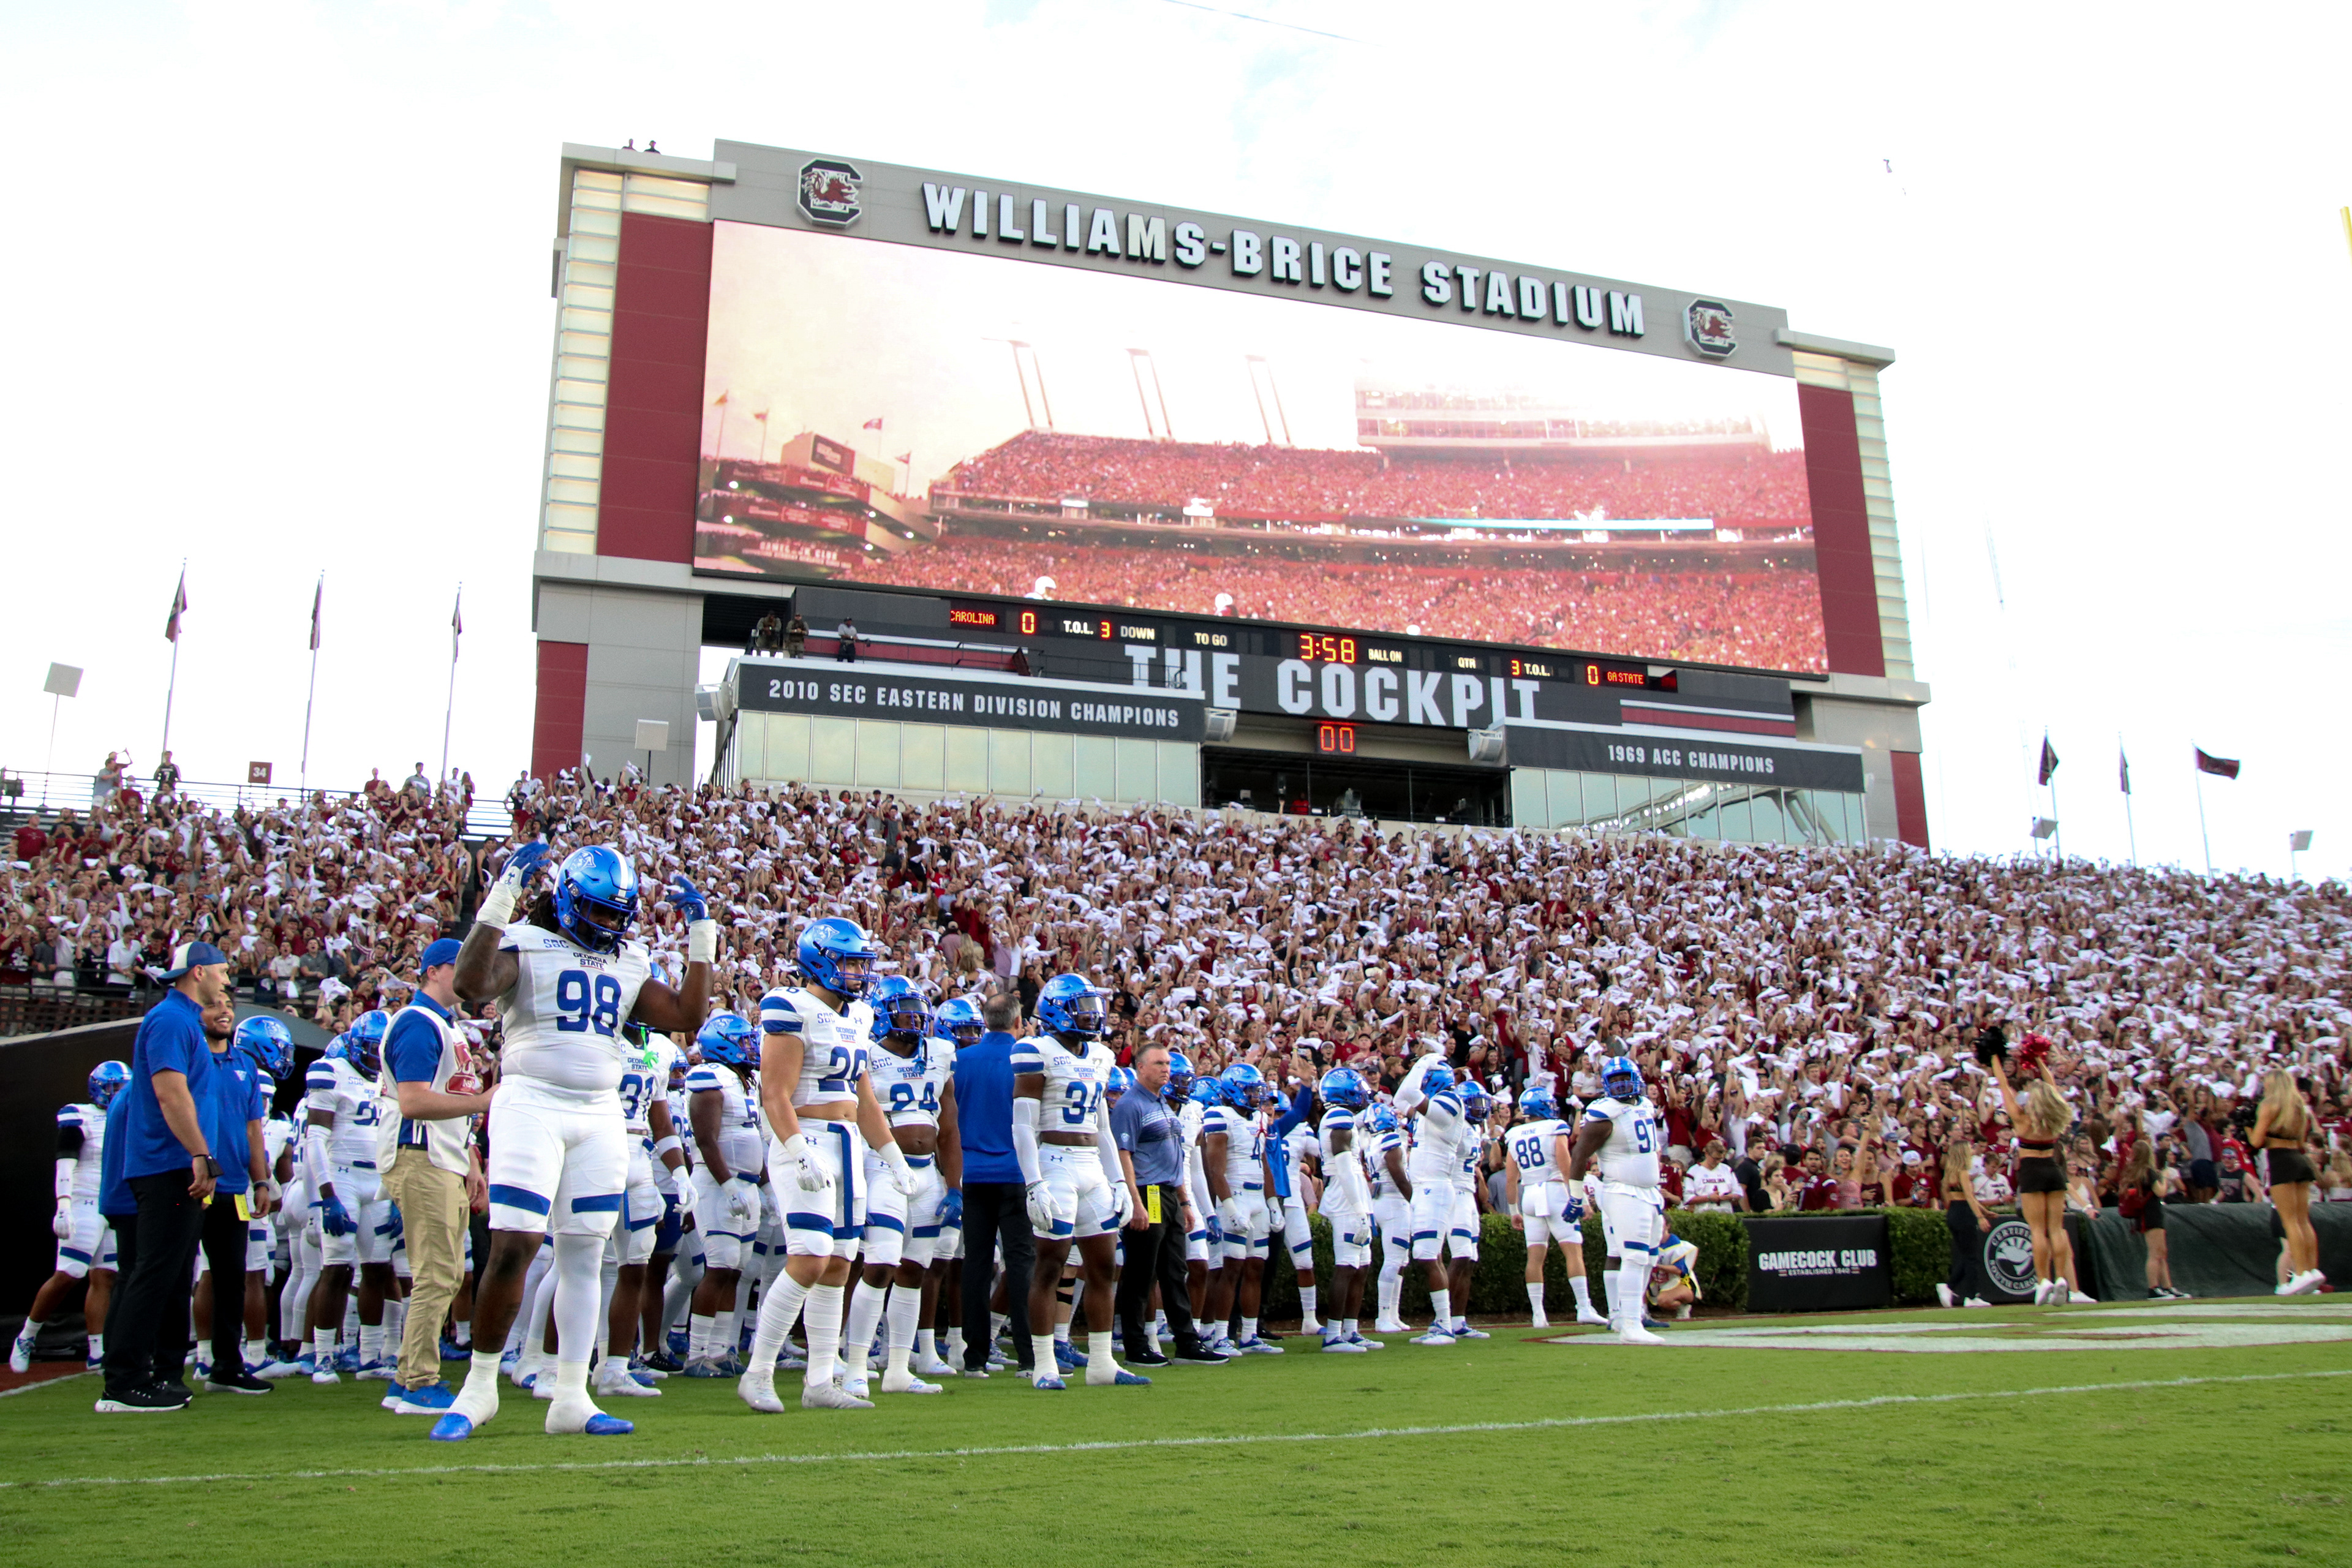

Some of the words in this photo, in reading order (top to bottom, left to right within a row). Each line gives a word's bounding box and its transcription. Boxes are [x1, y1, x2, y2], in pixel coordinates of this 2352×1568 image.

[922, 182, 1393, 298] WILLIAMS-BRICE
[1421, 260, 1645, 337] STADIUM
[1022, 612, 1035, 633] 0
[1063, 620, 1094, 635] T.O.L.
[1101, 622, 1110, 638] 3
[1120, 625, 1155, 640] DOWN
[1194, 632, 1210, 645] TO
[1212, 634, 1228, 647] GO
[1300, 634, 1355, 663] 3:58
[1368, 648, 1389, 662] BALL
[1389, 650, 1403, 663] ON
[1458, 657, 1476, 669] QTR
[1511, 660, 1520, 676] 3
[1524, 663, 1550, 676] T.O.L.
[1588, 665, 1599, 685] 0
[1607, 671, 1618, 682] GA
[1618, 673, 1645, 685] STATE
[1125, 644, 1241, 709] THE
[1277, 658, 1540, 728] COCKPIT
[769, 679, 819, 701] 2010
[829, 683, 866, 704] SEC
[876, 687, 964, 712] EASTERN
[974, 694, 1061, 719] DIVISION
[1070, 702, 1179, 728] CHAMPIONS
[1320, 725, 1354, 752] 00
[1608, 744, 1645, 763] 1969
[1653, 748, 1682, 766] ACC
[1688, 751, 1774, 774] CHAMPIONS
[253, 766, 267, 778] 34
[573, 952, 608, 965] GEORGIA
[579, 958, 605, 970] STATE
[556, 970, 622, 1038] 98
[836, 1027, 857, 1035] GEORGIA
[890, 1082, 938, 1115] 24
[1062, 1081, 1102, 1124] 34
[1634, 1118, 1656, 1153] 97
[1516, 1136, 1545, 1169] 88
[1758, 1250, 1838, 1271] GAMECOCK
[1840, 1249, 1877, 1268] CLUB
